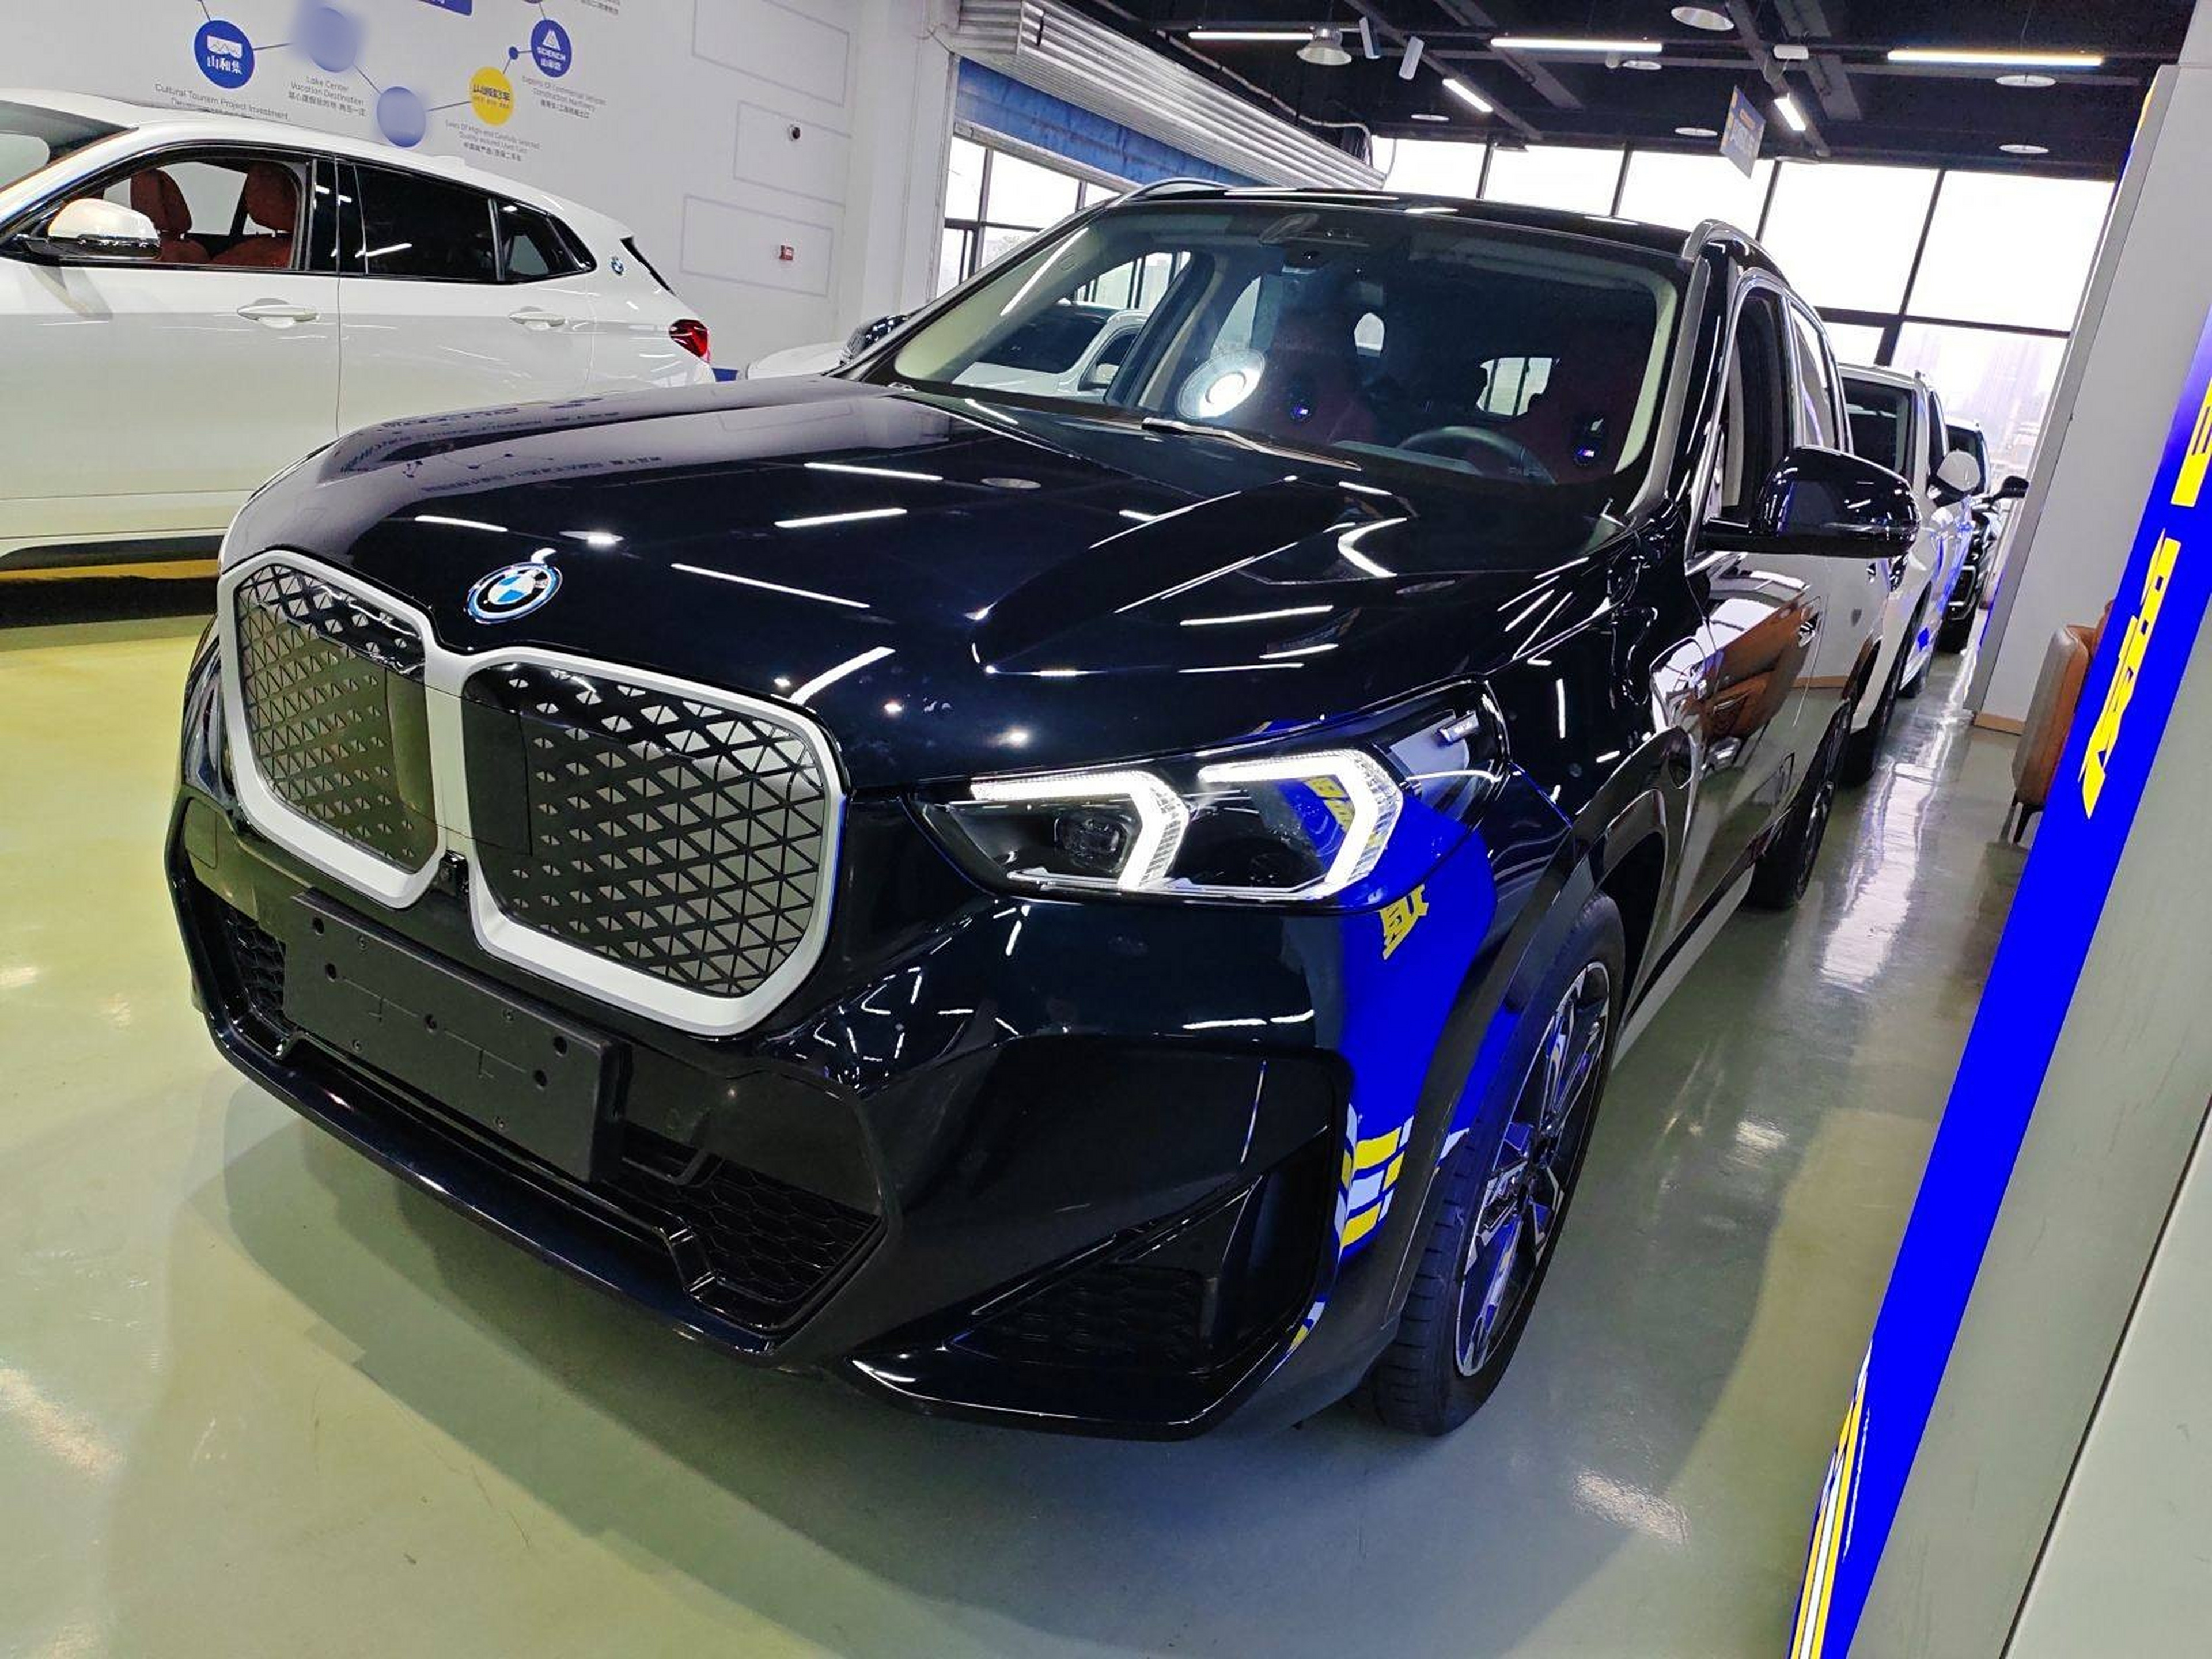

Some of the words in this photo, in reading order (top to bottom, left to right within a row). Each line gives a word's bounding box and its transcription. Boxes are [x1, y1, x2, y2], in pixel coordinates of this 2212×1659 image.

[207, 55, 243, 75] 山和集
[155, 84, 186, 97] Cultural
[188, 90, 218, 104] Tourism
[221, 98, 246, 110] Project
[249, 105, 288, 119] Investment
